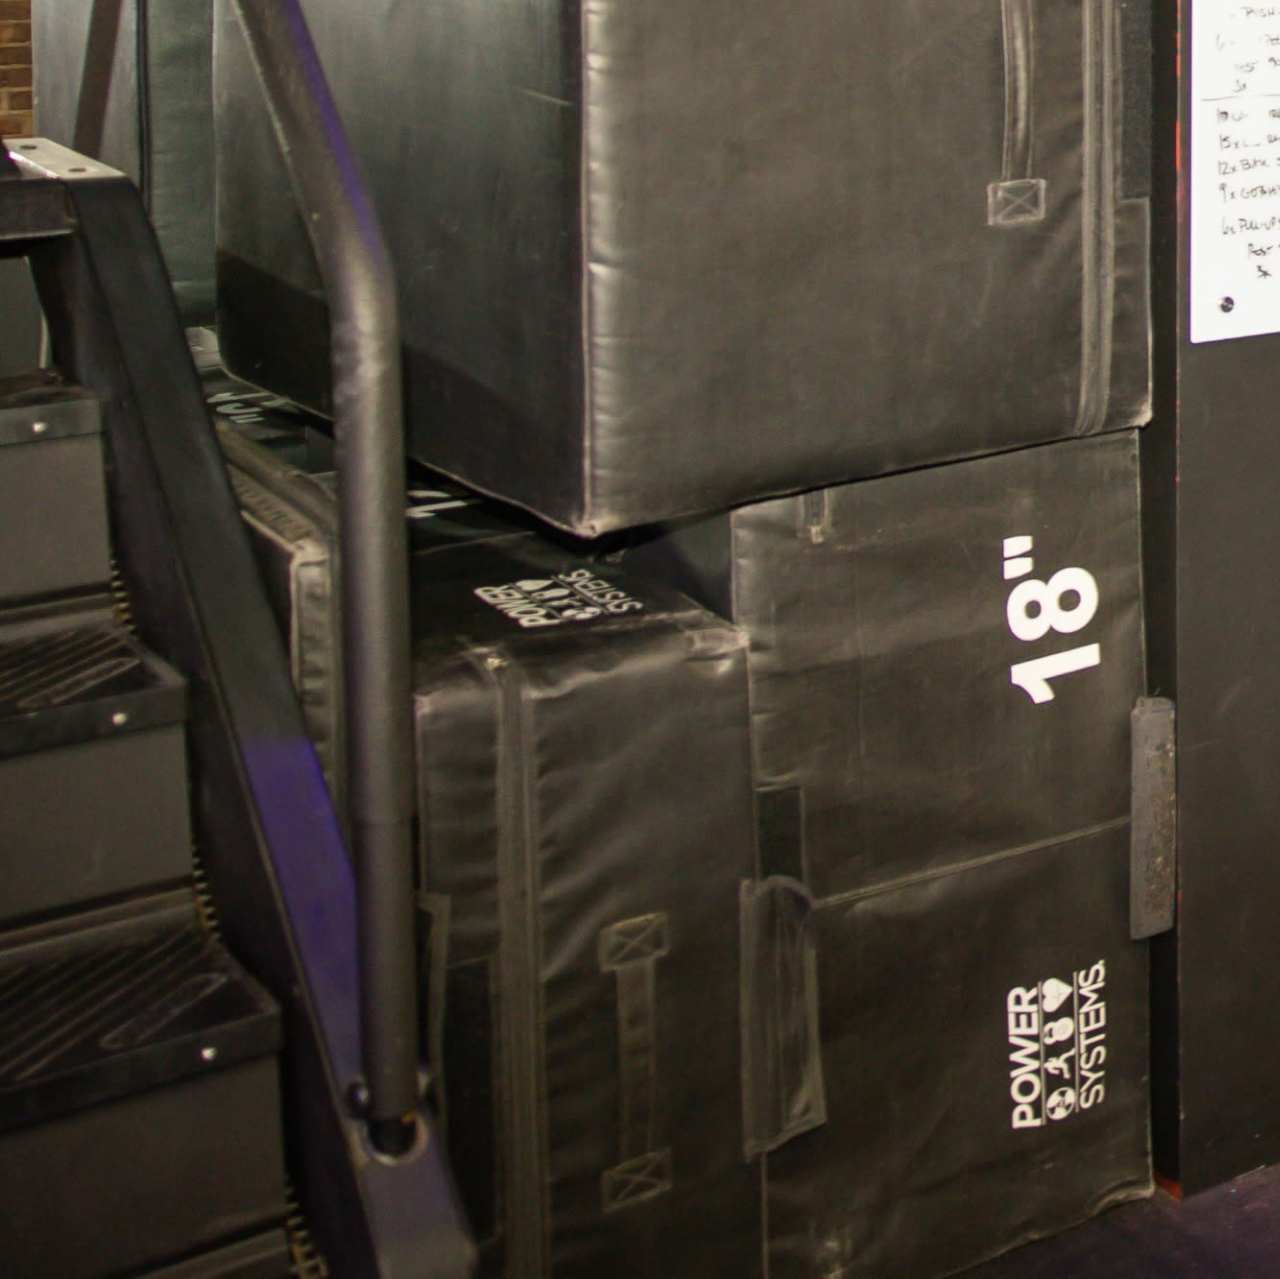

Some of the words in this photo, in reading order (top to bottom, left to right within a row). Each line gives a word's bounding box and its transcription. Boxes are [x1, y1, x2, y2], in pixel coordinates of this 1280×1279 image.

[473, 585, 562, 628] POWER
[557, 568, 644, 614] SYSTEMS
[1002, 535, 1101, 705] 18"
[1007, 986, 1043, 1130] POWER
[1078, 959, 1106, 1110] SYSTEMS
